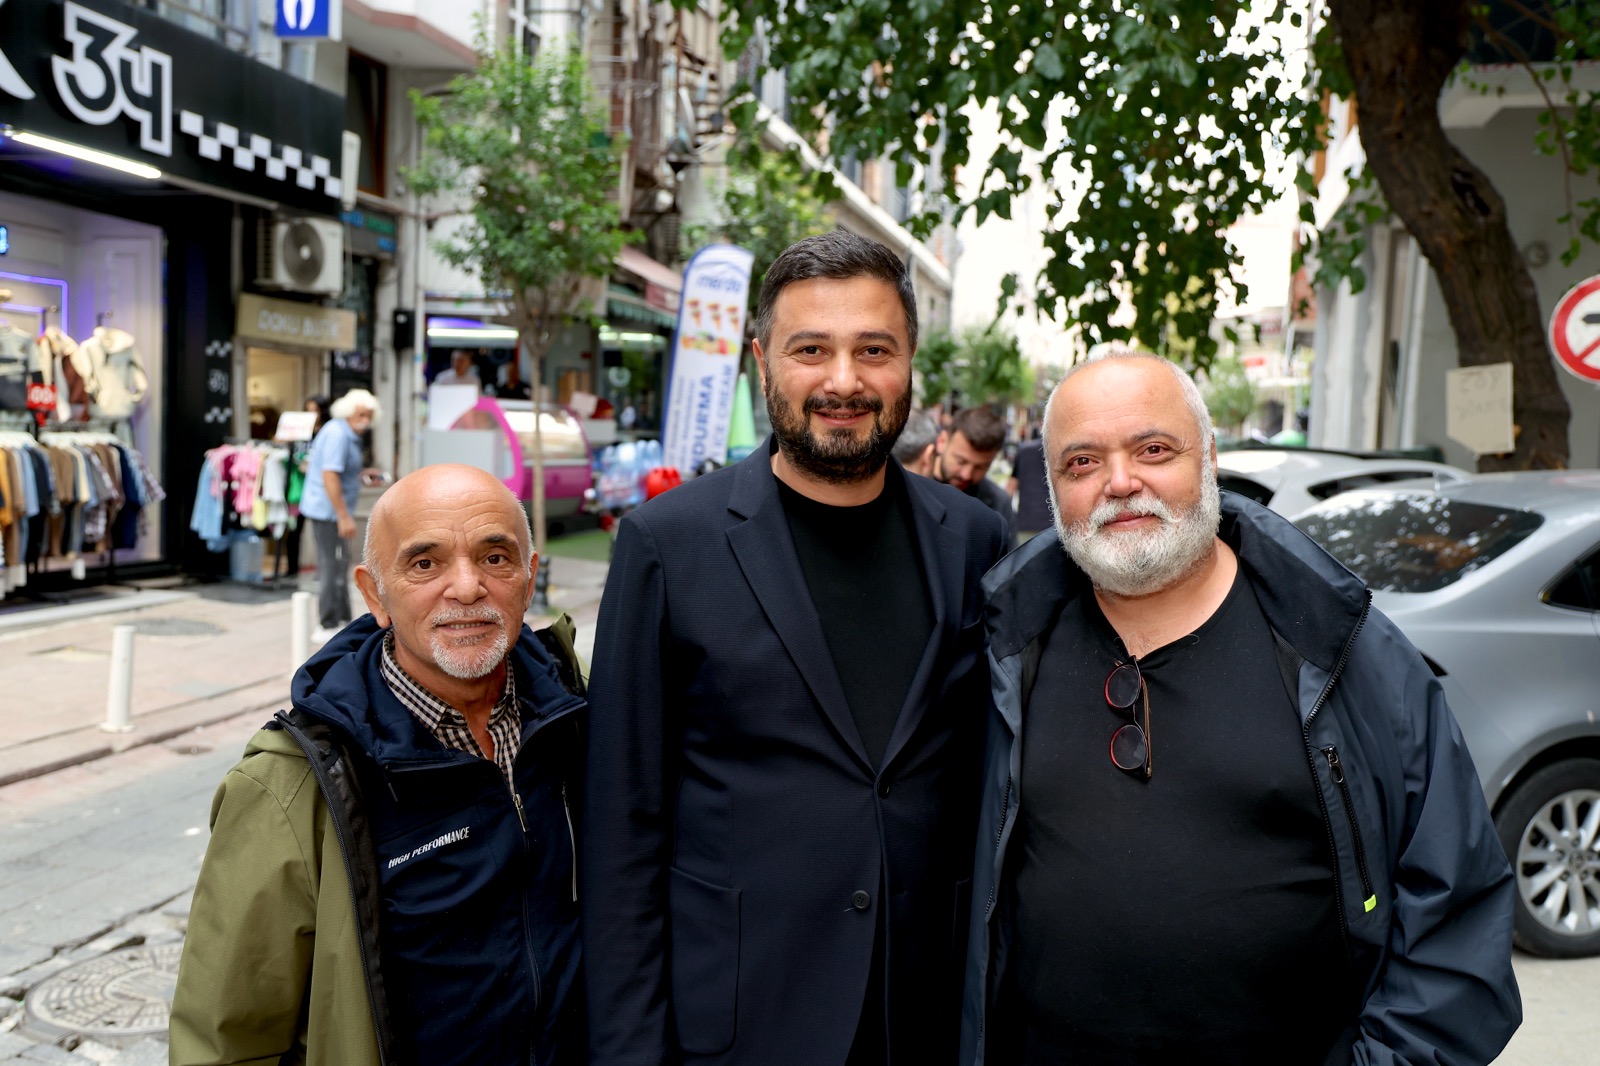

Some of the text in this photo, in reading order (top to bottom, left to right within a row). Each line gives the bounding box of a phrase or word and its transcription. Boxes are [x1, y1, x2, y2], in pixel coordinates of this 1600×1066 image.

[52, 0, 172, 157] 34
[388, 826, 470, 869] HIGH PERFORMANCE
